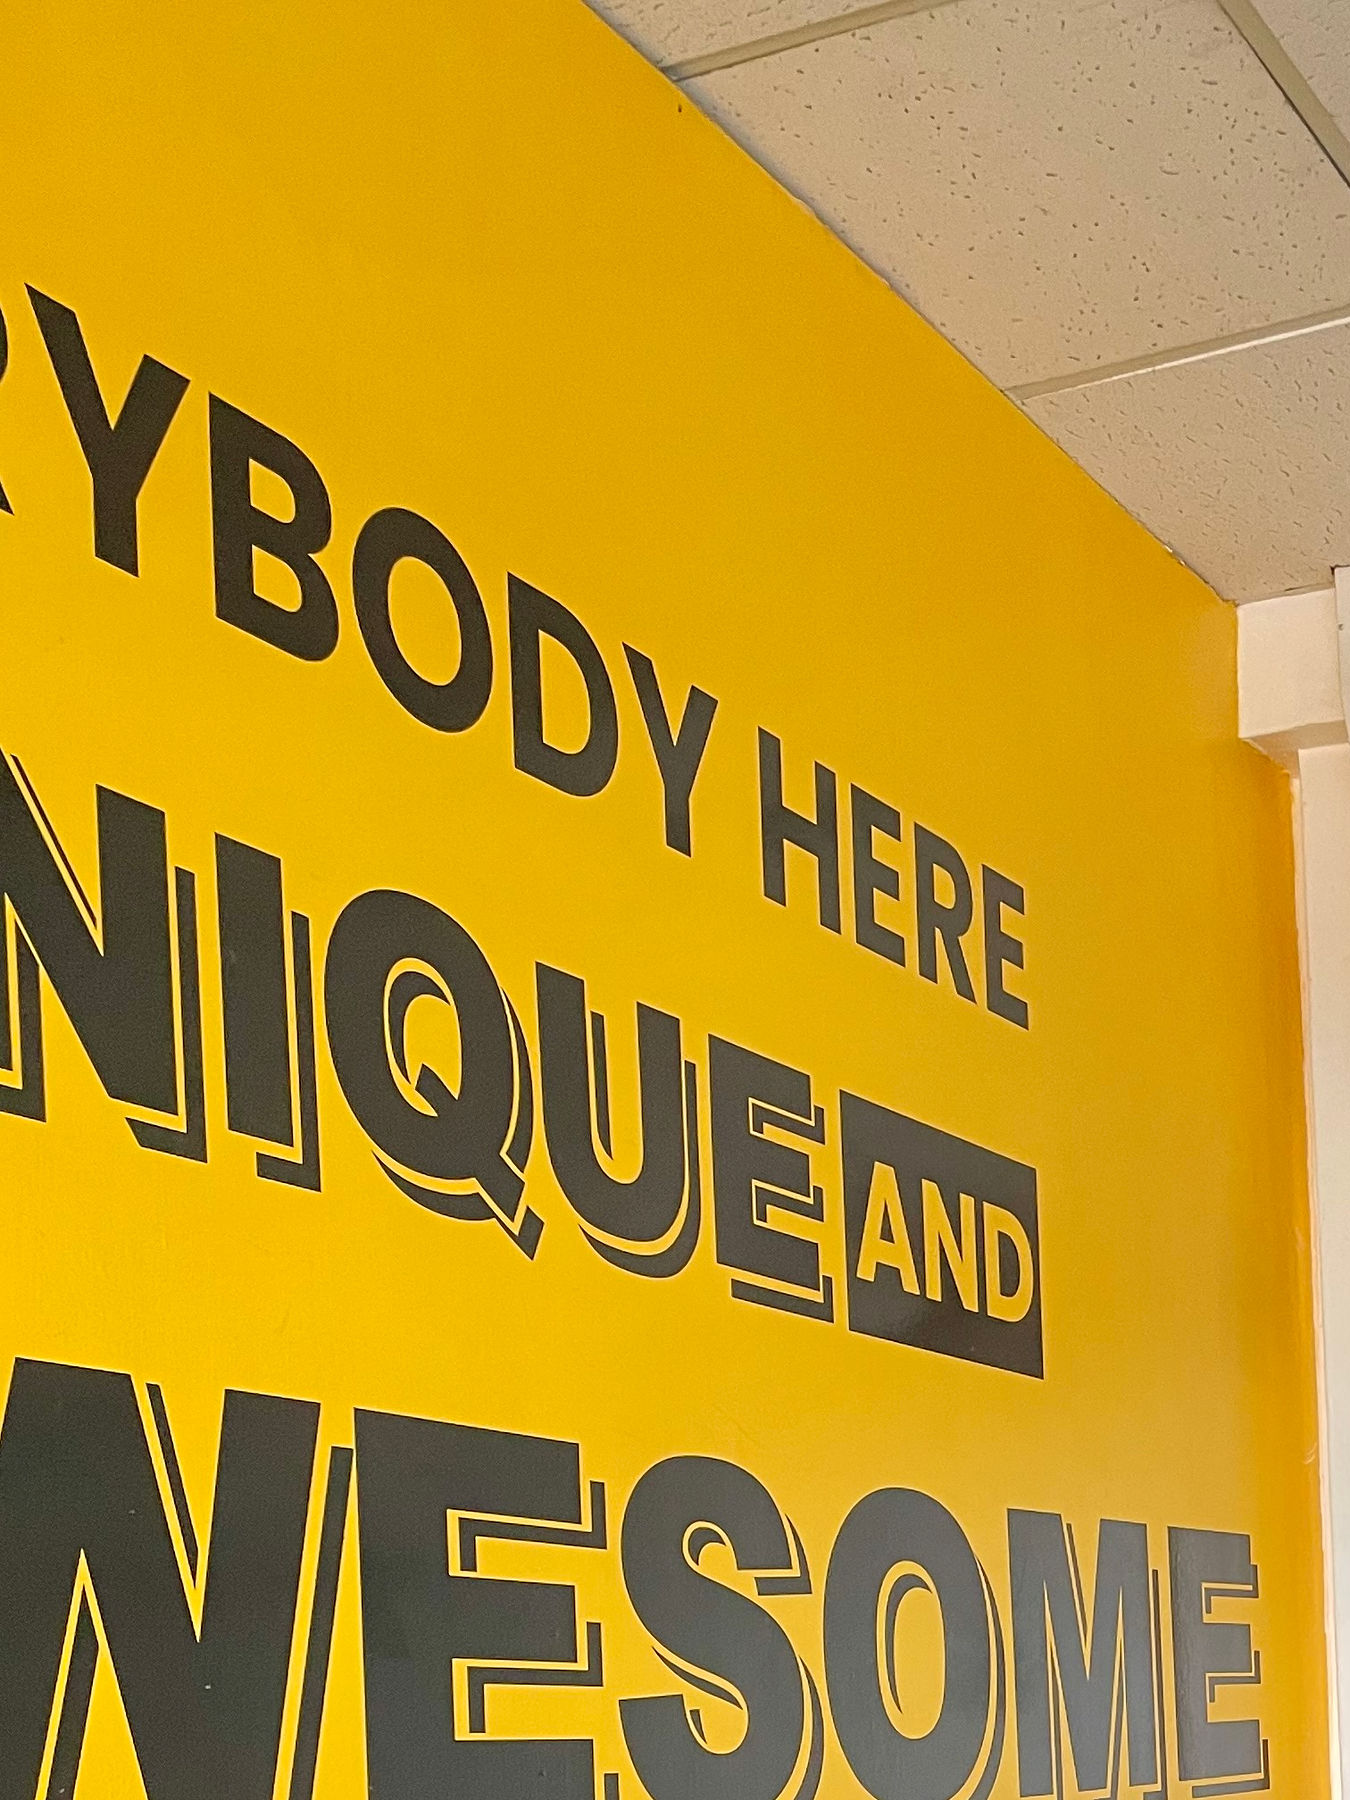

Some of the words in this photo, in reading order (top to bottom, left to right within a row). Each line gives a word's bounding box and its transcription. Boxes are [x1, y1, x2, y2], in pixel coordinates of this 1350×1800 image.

[0, 282, 718, 858] YBODY
[757, 725, 1030, 1031] HERE
[0, 748, 834, 1322] NIQUE
[856, 1167, 1034, 1323] AND
